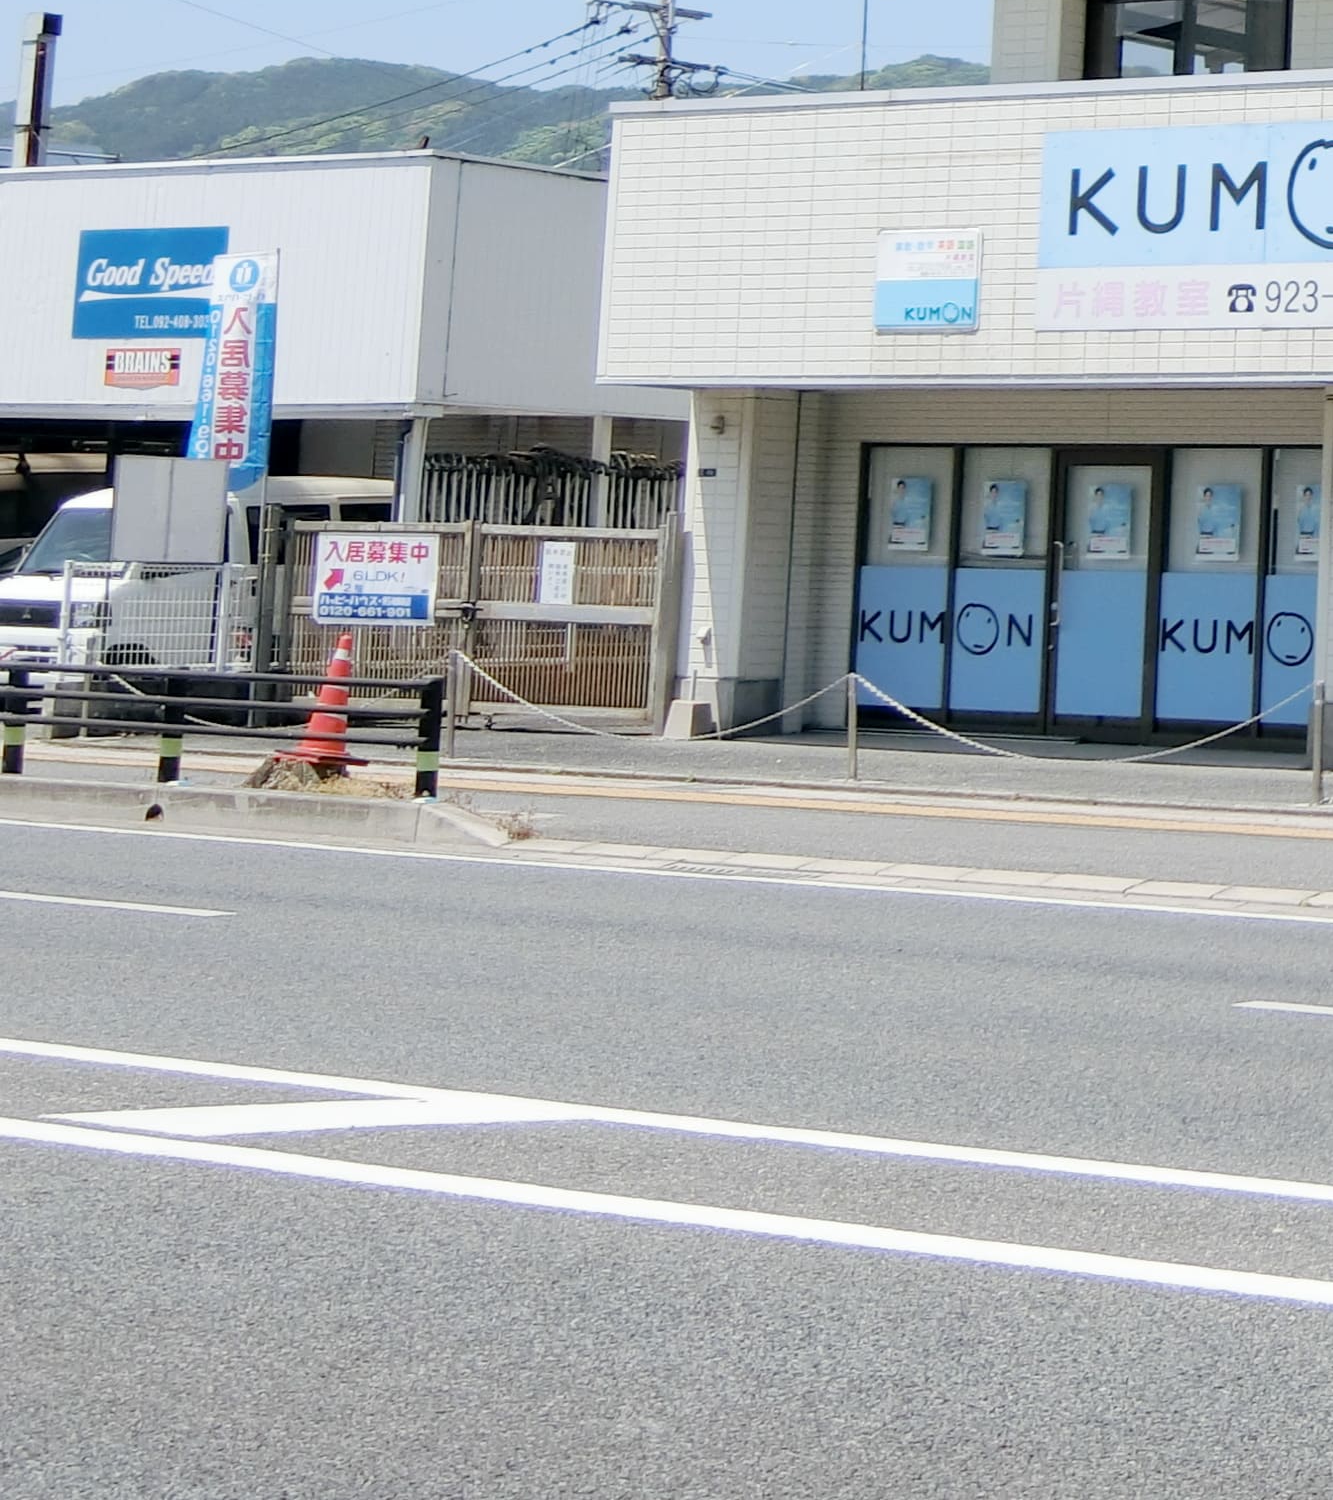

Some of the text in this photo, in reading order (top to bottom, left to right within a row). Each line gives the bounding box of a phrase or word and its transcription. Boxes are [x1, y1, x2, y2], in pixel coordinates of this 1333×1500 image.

[86, 258, 146, 287] Good
[903, 301, 973, 324] KUMON
[1053, 280, 1211, 320] 片縄教室
[114, 350, 172, 373] BRAINS
[324, 540, 429, 564] 入居募集中
[859, 602, 1034, 656] KUMON
[1160, 611, 1315, 667] KUMO
